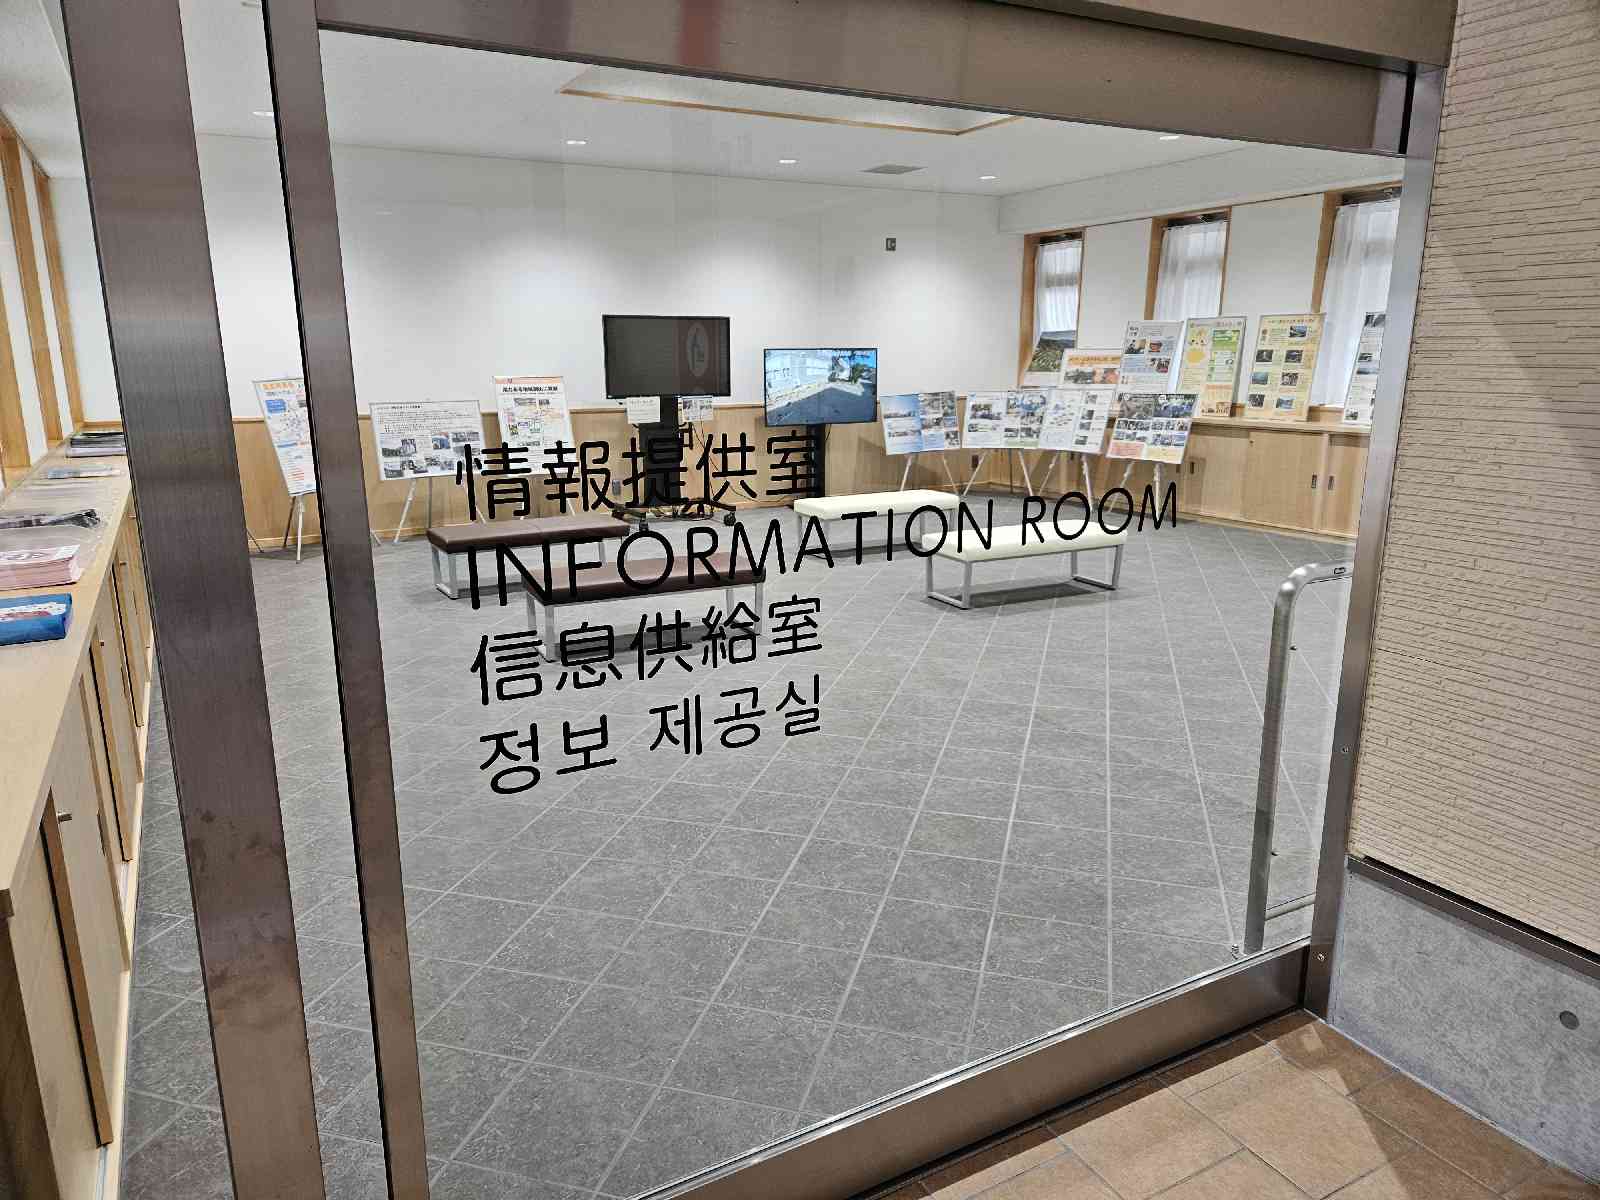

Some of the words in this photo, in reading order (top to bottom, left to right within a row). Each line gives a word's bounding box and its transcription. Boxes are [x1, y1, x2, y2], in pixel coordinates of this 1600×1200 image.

[456, 430, 817, 521] 情報提供室
[467, 499, 994, 610] INFORMATION
[1021, 481, 1177, 546] ROOM
[470, 594, 823, 706] 信息供給室
[479, 713, 618, 795] 정보
[648, 673, 821, 756] 제공실
